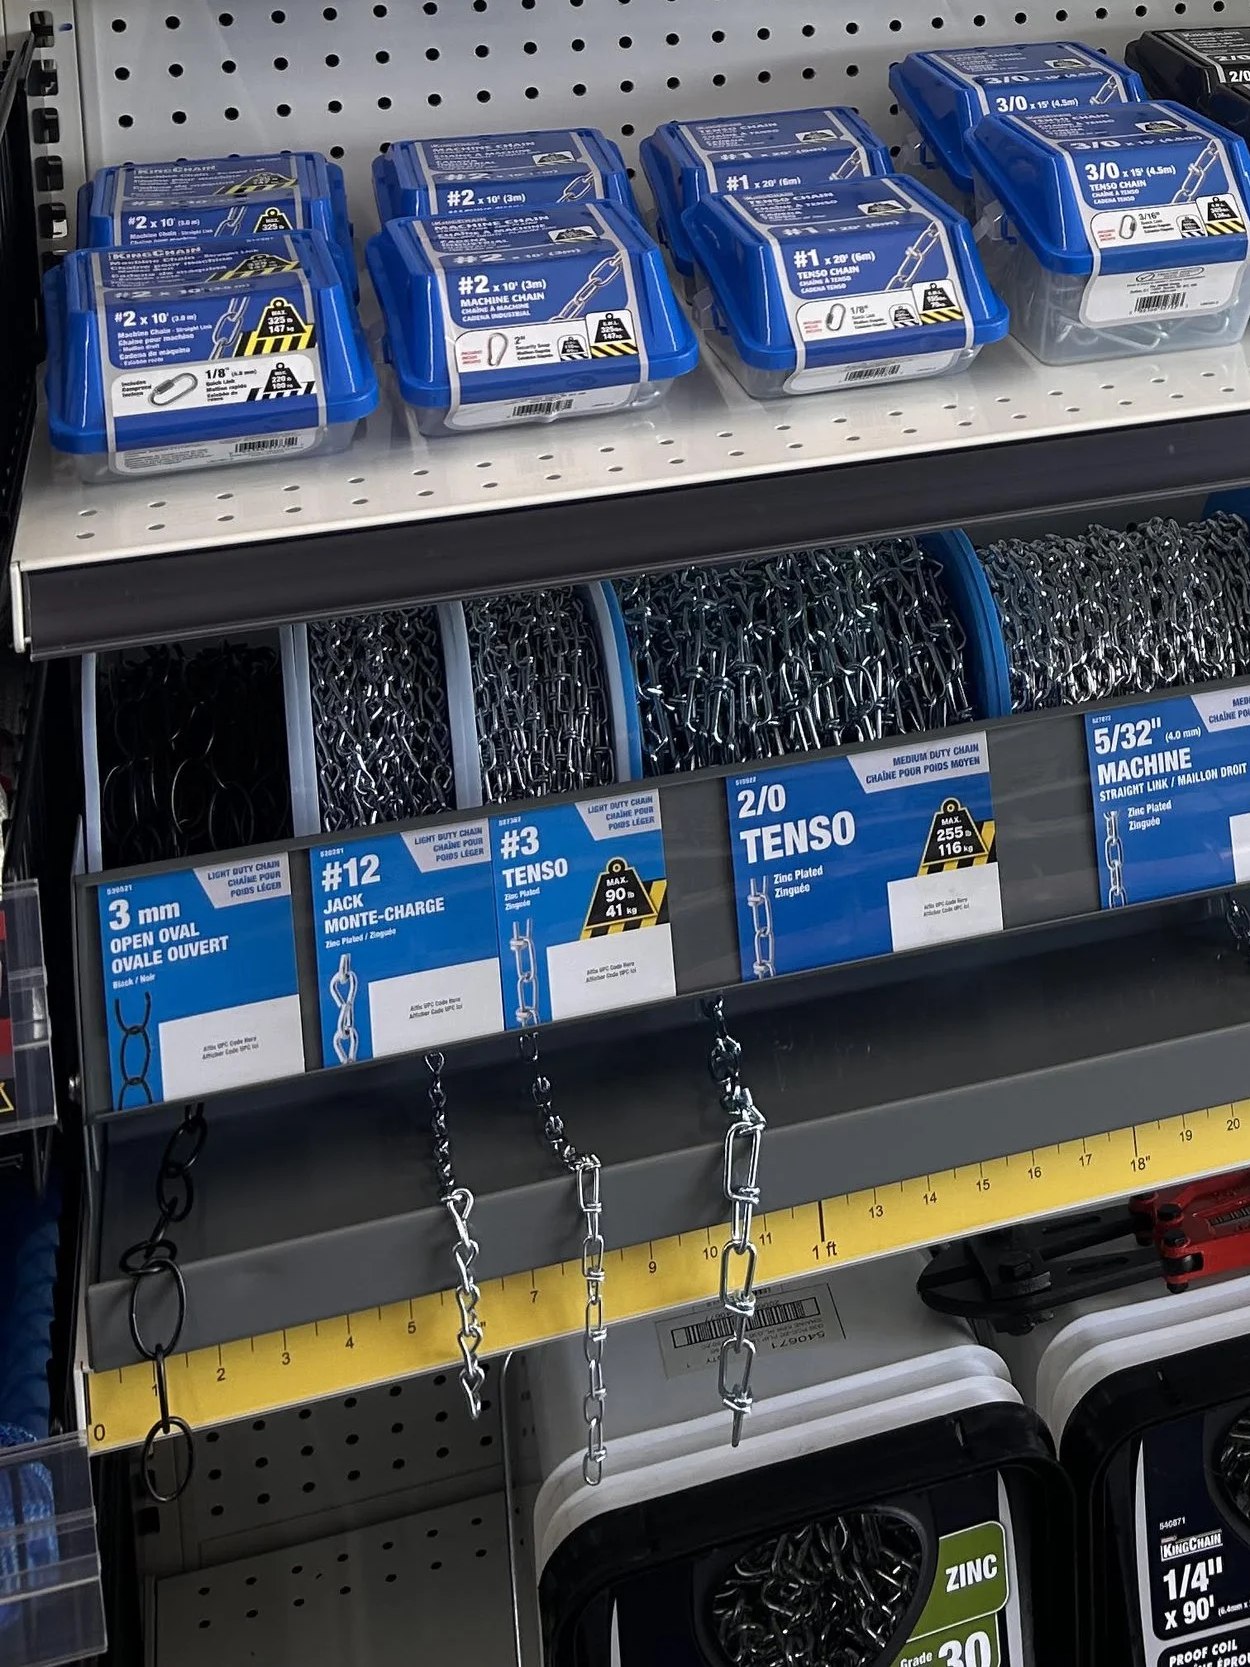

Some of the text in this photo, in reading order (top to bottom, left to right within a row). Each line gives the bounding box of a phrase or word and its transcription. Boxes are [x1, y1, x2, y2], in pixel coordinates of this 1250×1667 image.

[996, 95, 1078, 112] 3/0 (4.5m)
[1084, 161, 1176, 180] 3/0 15' (4.5m)
[1088, 179, 1146, 192] TENSO CHAIN
[447, 189, 475, 207] #2
[794, 249, 876, 267] #1 20' (6m)
[797, 265, 860, 280] TENSO CHAIN
[458, 275, 547, 295] #2 (3m)
[460, 291, 545, 308] MACHINE CHAIN
[115, 310, 136, 327] #2
[1094, 716, 1202, 755] 5/32" (4.0 mm)
[893, 742, 980, 766] MEDIUM DUTY CHAIN
[866, 755, 980, 785] CHAÎNE POUR POIDS MOYEN
[1098, 746, 1193, 785] MACHINE
[1099, 762, 1248, 803] STRAIGHT LINK MAILLON DROIT
[587, 795, 653, 815] LIGHT DUTY CHAIN
[737, 783, 786, 819] 2/0
[1128, 799, 1172, 818] Zinc Plated
[941, 816, 962, 826] MAX.
[500, 825, 541, 860] #3
[739, 810, 856, 865] TENSO
[936, 827, 964, 841] 255
[938, 841, 962, 856] 116
[320, 852, 381, 893] #12
[502, 857, 569, 890] TENSO
[606, 875, 629, 887] MAX.
[774, 864, 824, 885] Zinc Plated
[323, 893, 364, 916] JACK
[605, 887, 626, 902] 90
[109, 898, 181, 931] 3 mm
[323, 895, 446, 936] MONTE-CHARGE
[606, 904, 623, 919] 41
[110, 921, 200, 954] OPEN OVAL
[111, 935, 229, 975] OVALE OUVERT
[1130, 1154, 1152, 1172] 18"
[702, 1244, 718, 1260] 10
[825, 1241, 838, 1257] ft
[944, 1552, 998, 1594] ZINC
[1162, 1555, 1224, 1602] 1/4"
[1164, 1595, 1214, 1631] x 90'
